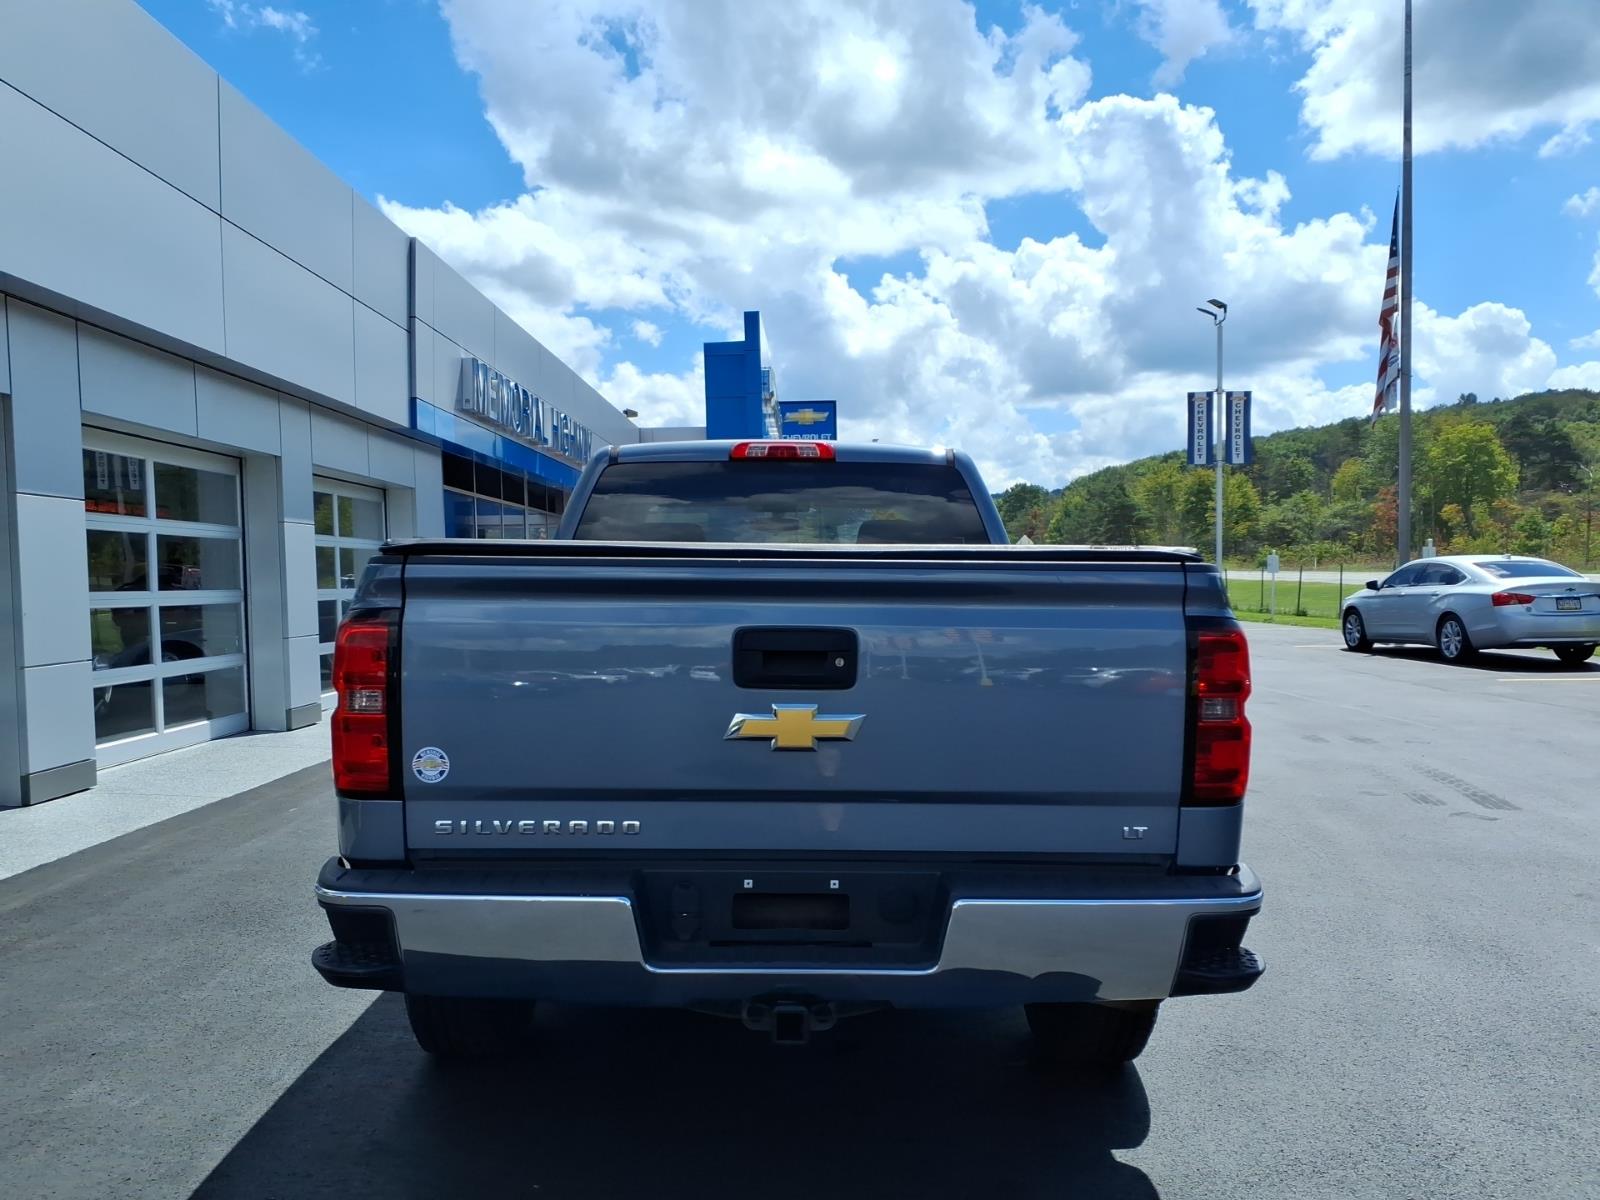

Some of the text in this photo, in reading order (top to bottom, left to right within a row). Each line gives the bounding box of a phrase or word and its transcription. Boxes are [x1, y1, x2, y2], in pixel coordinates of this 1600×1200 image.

[1196, 402, 1204, 460] CHEVROLET
[1234, 402, 1242, 459] CHEVROLET
[434, 820, 641, 835] SILVERADO
[1123, 826, 1149, 839] LT
